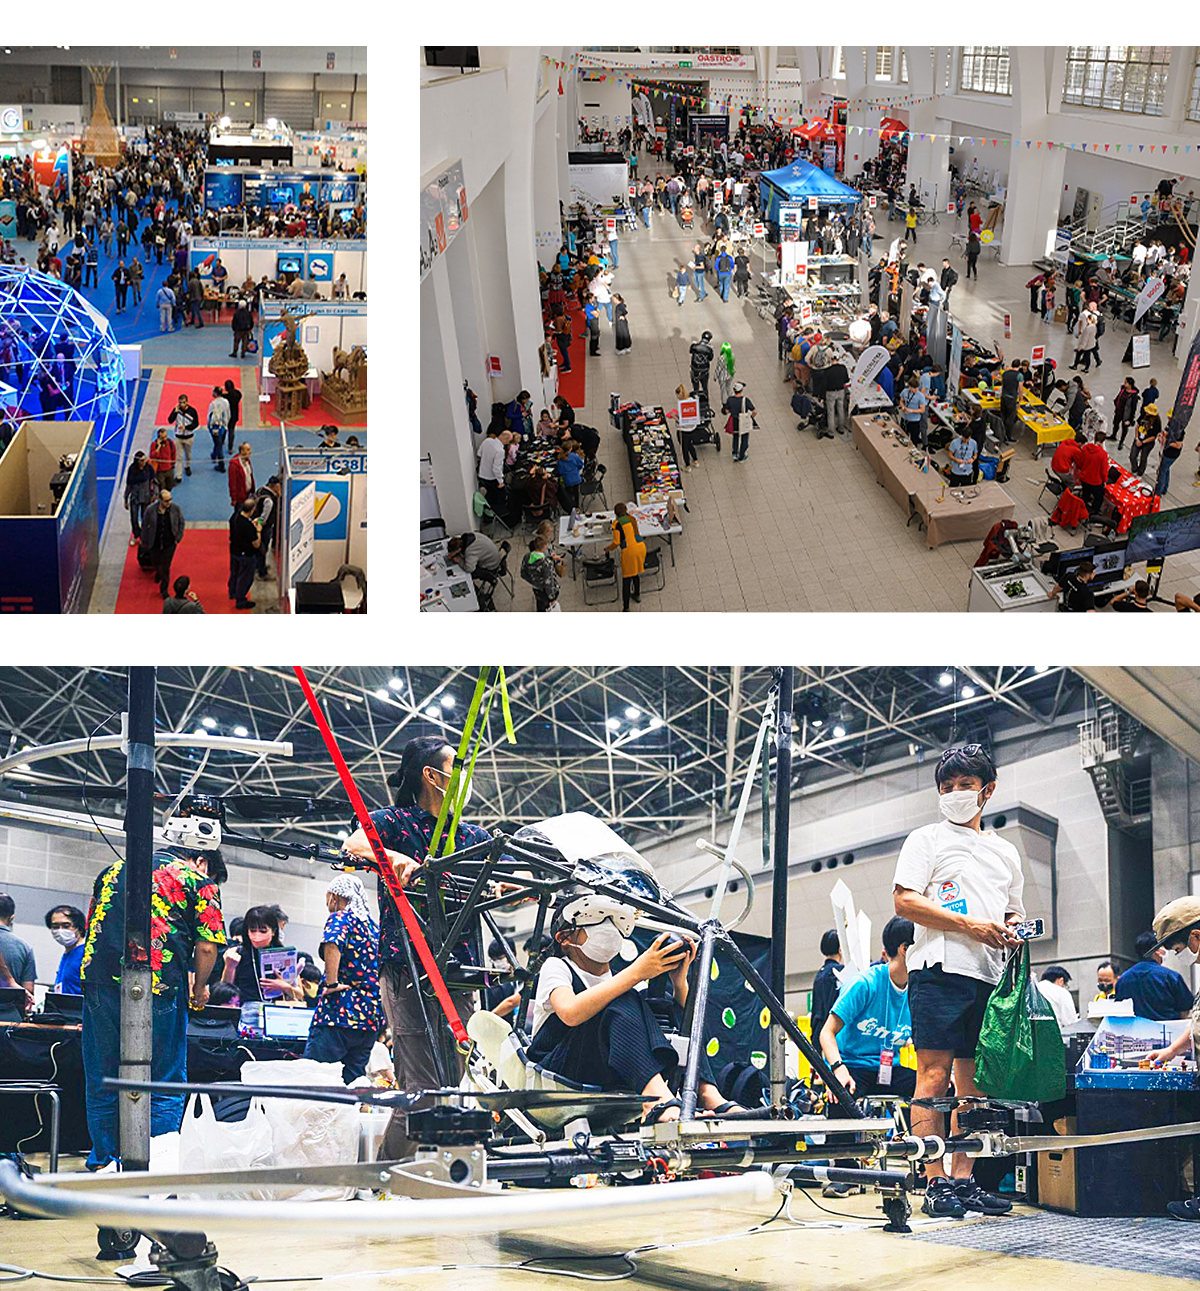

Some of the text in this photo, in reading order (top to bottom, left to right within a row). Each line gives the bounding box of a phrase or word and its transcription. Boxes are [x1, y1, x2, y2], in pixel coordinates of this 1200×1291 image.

[1147, 282, 1162, 298] BOSCH
[331, 458, 359, 471] C38
[370, 838, 403, 898] ANCRA
